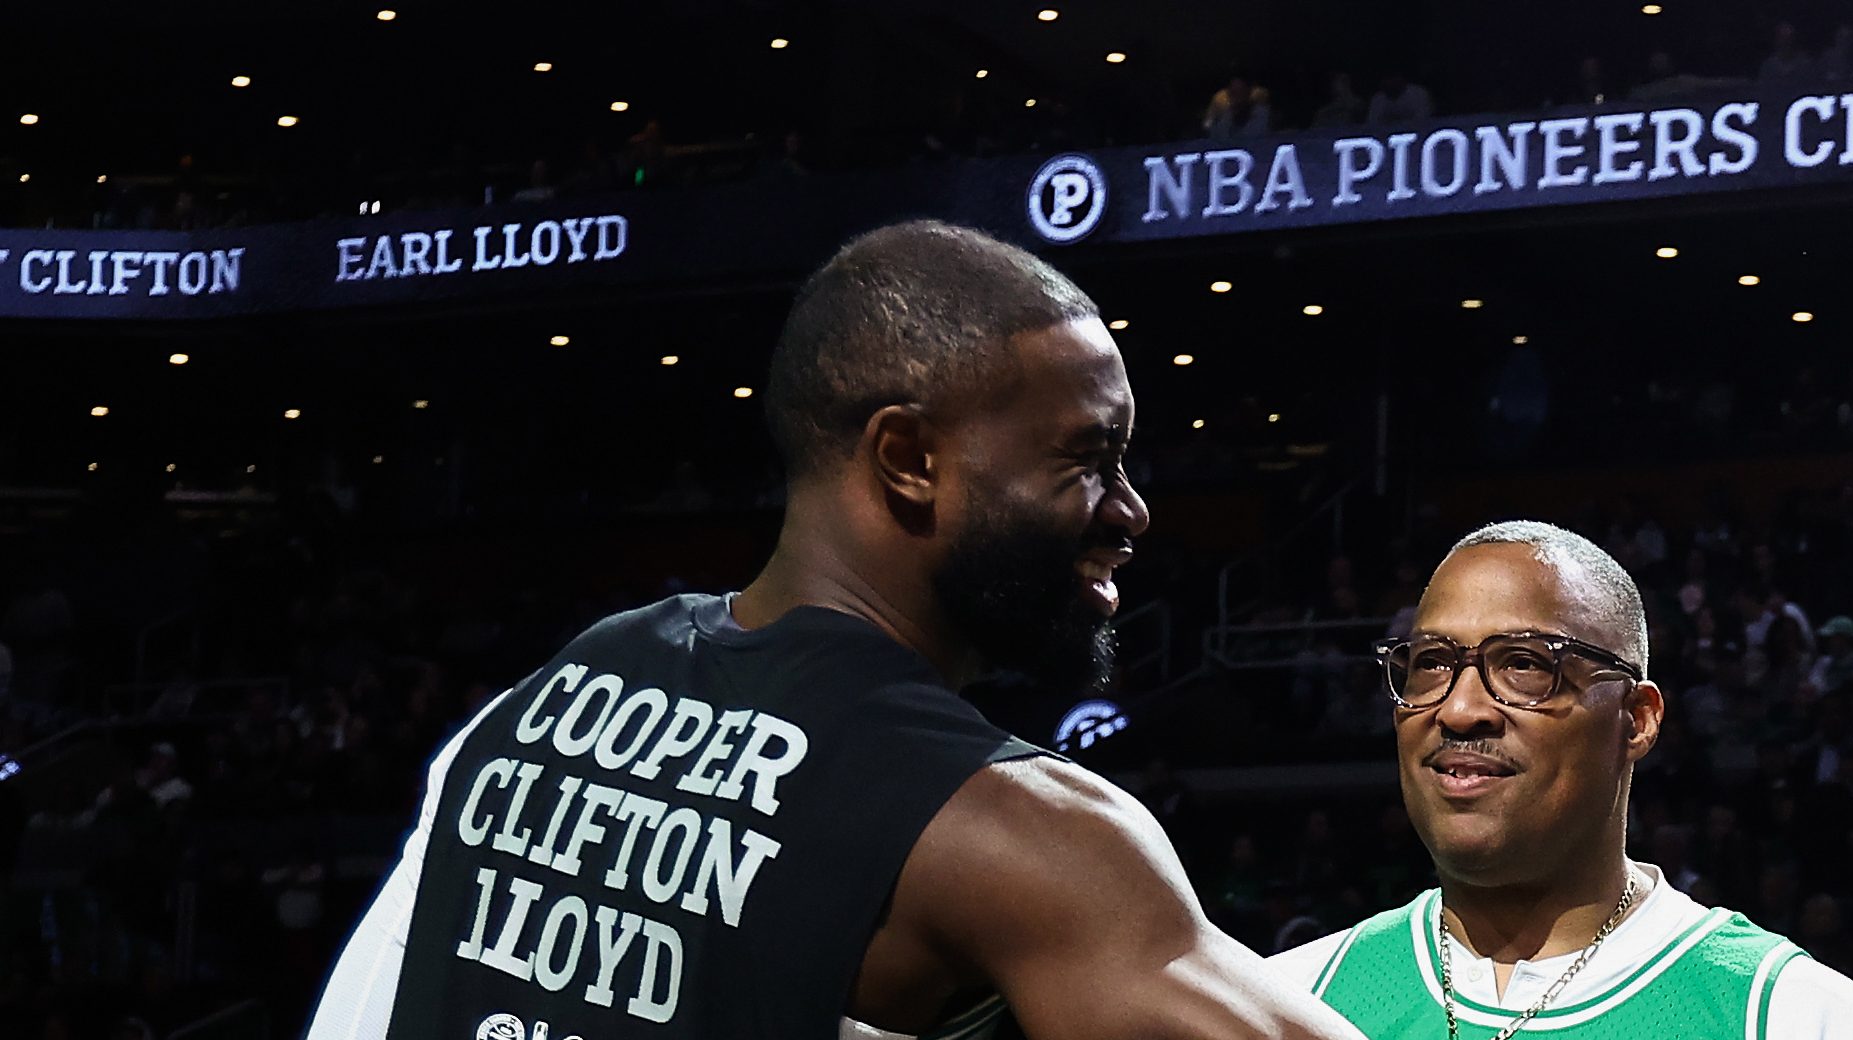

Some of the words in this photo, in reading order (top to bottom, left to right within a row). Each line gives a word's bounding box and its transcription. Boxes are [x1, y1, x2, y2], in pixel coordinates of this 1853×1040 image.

[1142, 144, 1314, 223] NBA
[1331, 101, 1759, 207] PIONEERS
[20, 247, 246, 296] CLIFTON
[336, 229, 463, 283] EARL
[472, 215, 629, 272] LLOYD
[516, 663, 808, 816] COOPER
[458, 758, 782, 928] CLIFTON
